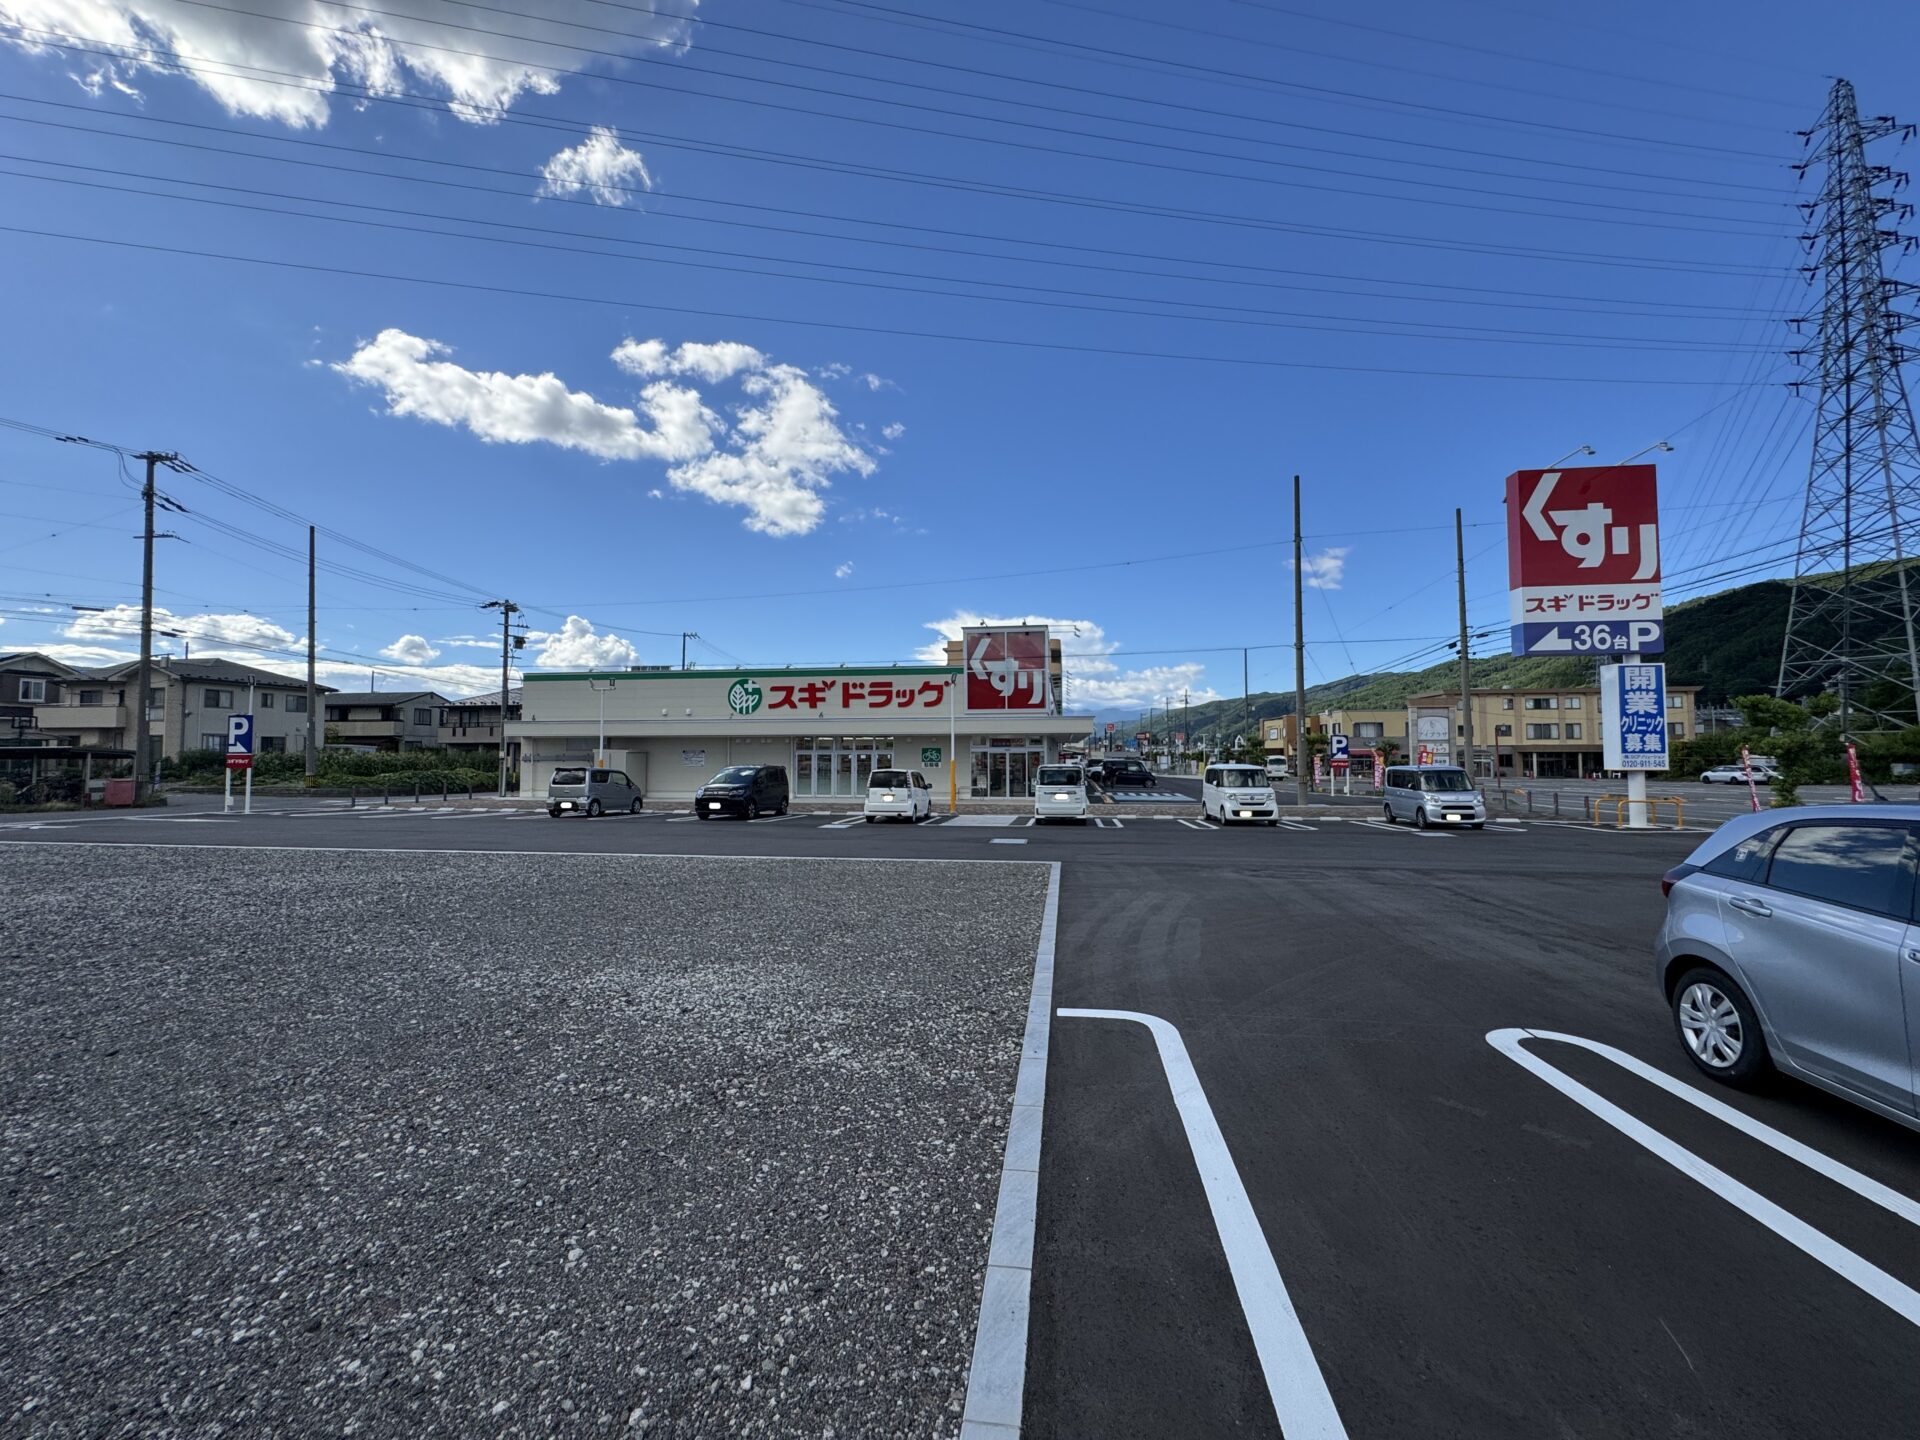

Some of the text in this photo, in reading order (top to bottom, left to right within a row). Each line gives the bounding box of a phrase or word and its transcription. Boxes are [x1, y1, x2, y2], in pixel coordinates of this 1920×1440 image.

[1522, 472, 1658, 580] くすり
[1525, 593, 1659, 613] スギドラッグ
[969, 638, 1044, 705] くすり
[768, 680, 953, 709] スギドラッグ
[1624, 666, 1658, 715] 開業
[228, 717, 249, 744] P
[1620, 715, 1664, 732] クリニック
[1331, 736, 1348, 754] P
[1624, 732, 1662, 752] 募集
[1621, 760, 1666, 768] 0120-911-545
